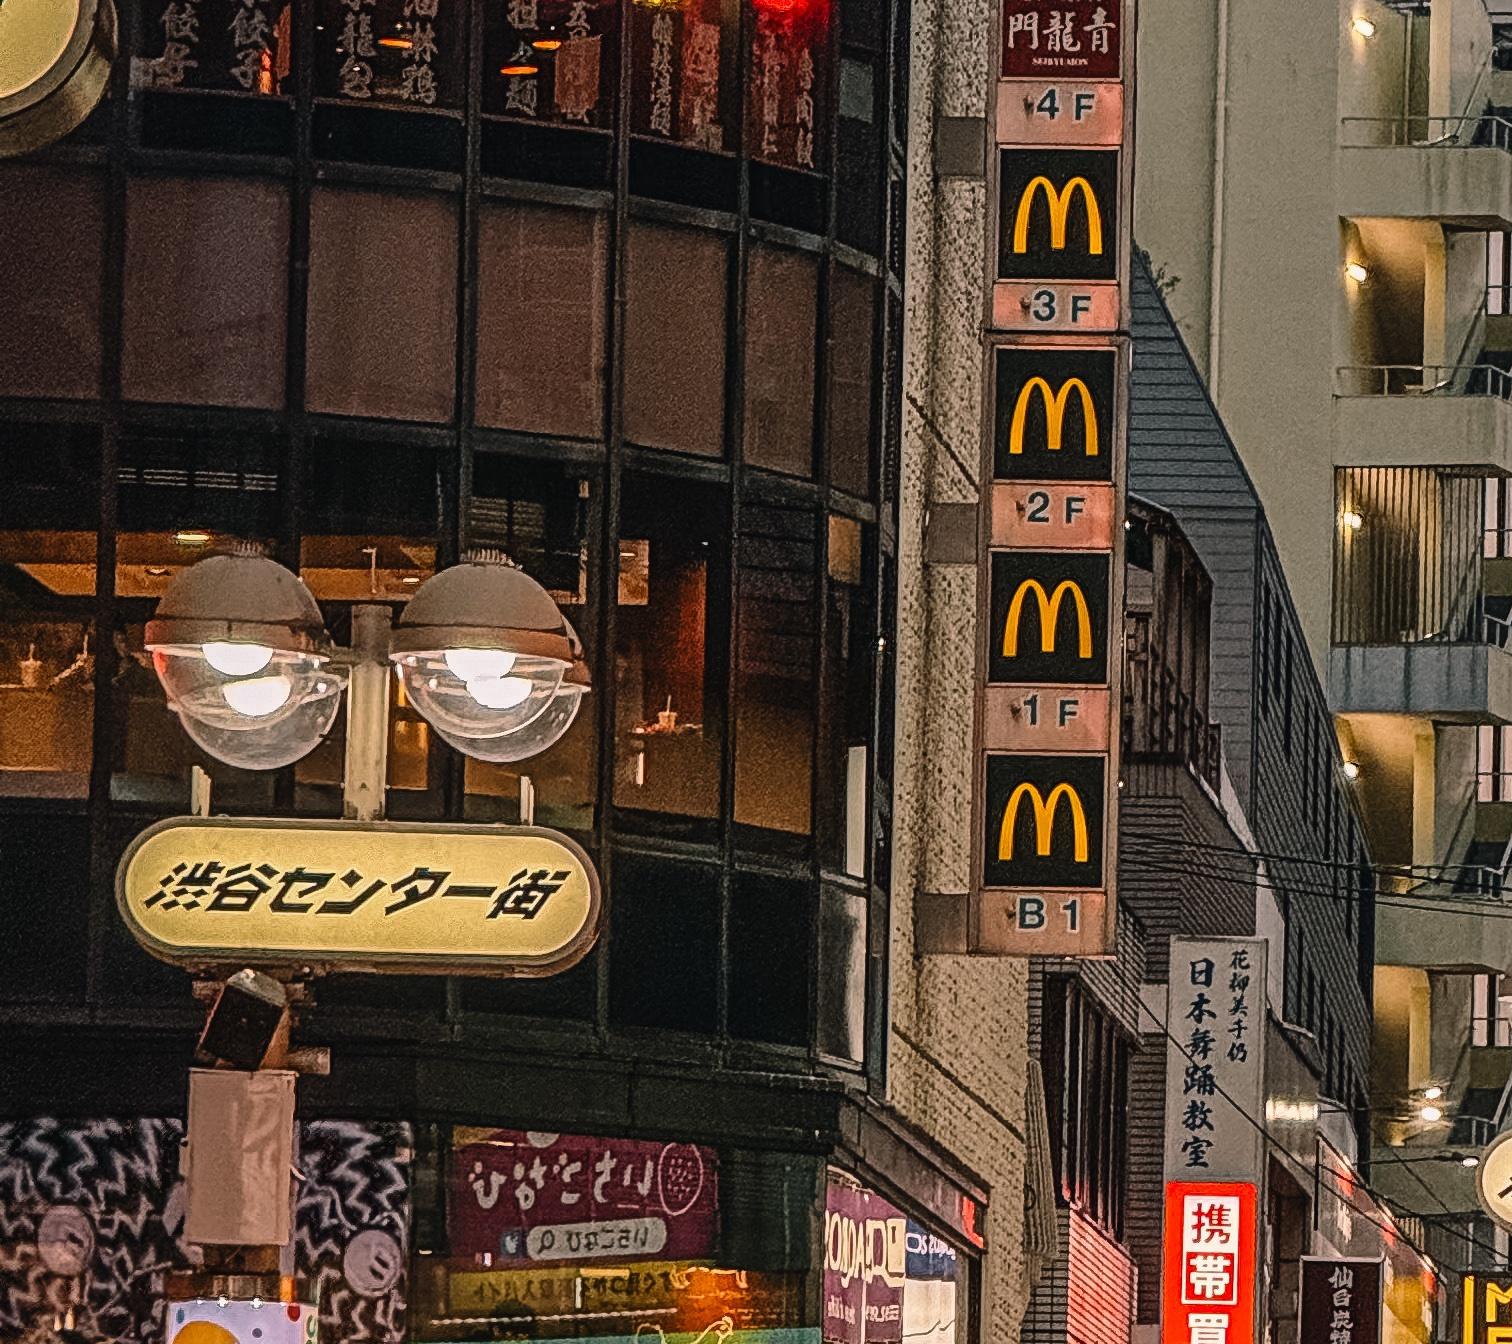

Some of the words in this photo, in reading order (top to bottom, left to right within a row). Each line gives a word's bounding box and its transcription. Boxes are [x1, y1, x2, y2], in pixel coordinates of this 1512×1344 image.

[144, 859, 572, 921] 渋谷センター街
[1181, 957, 1218, 1169] 日本舞踊教室
